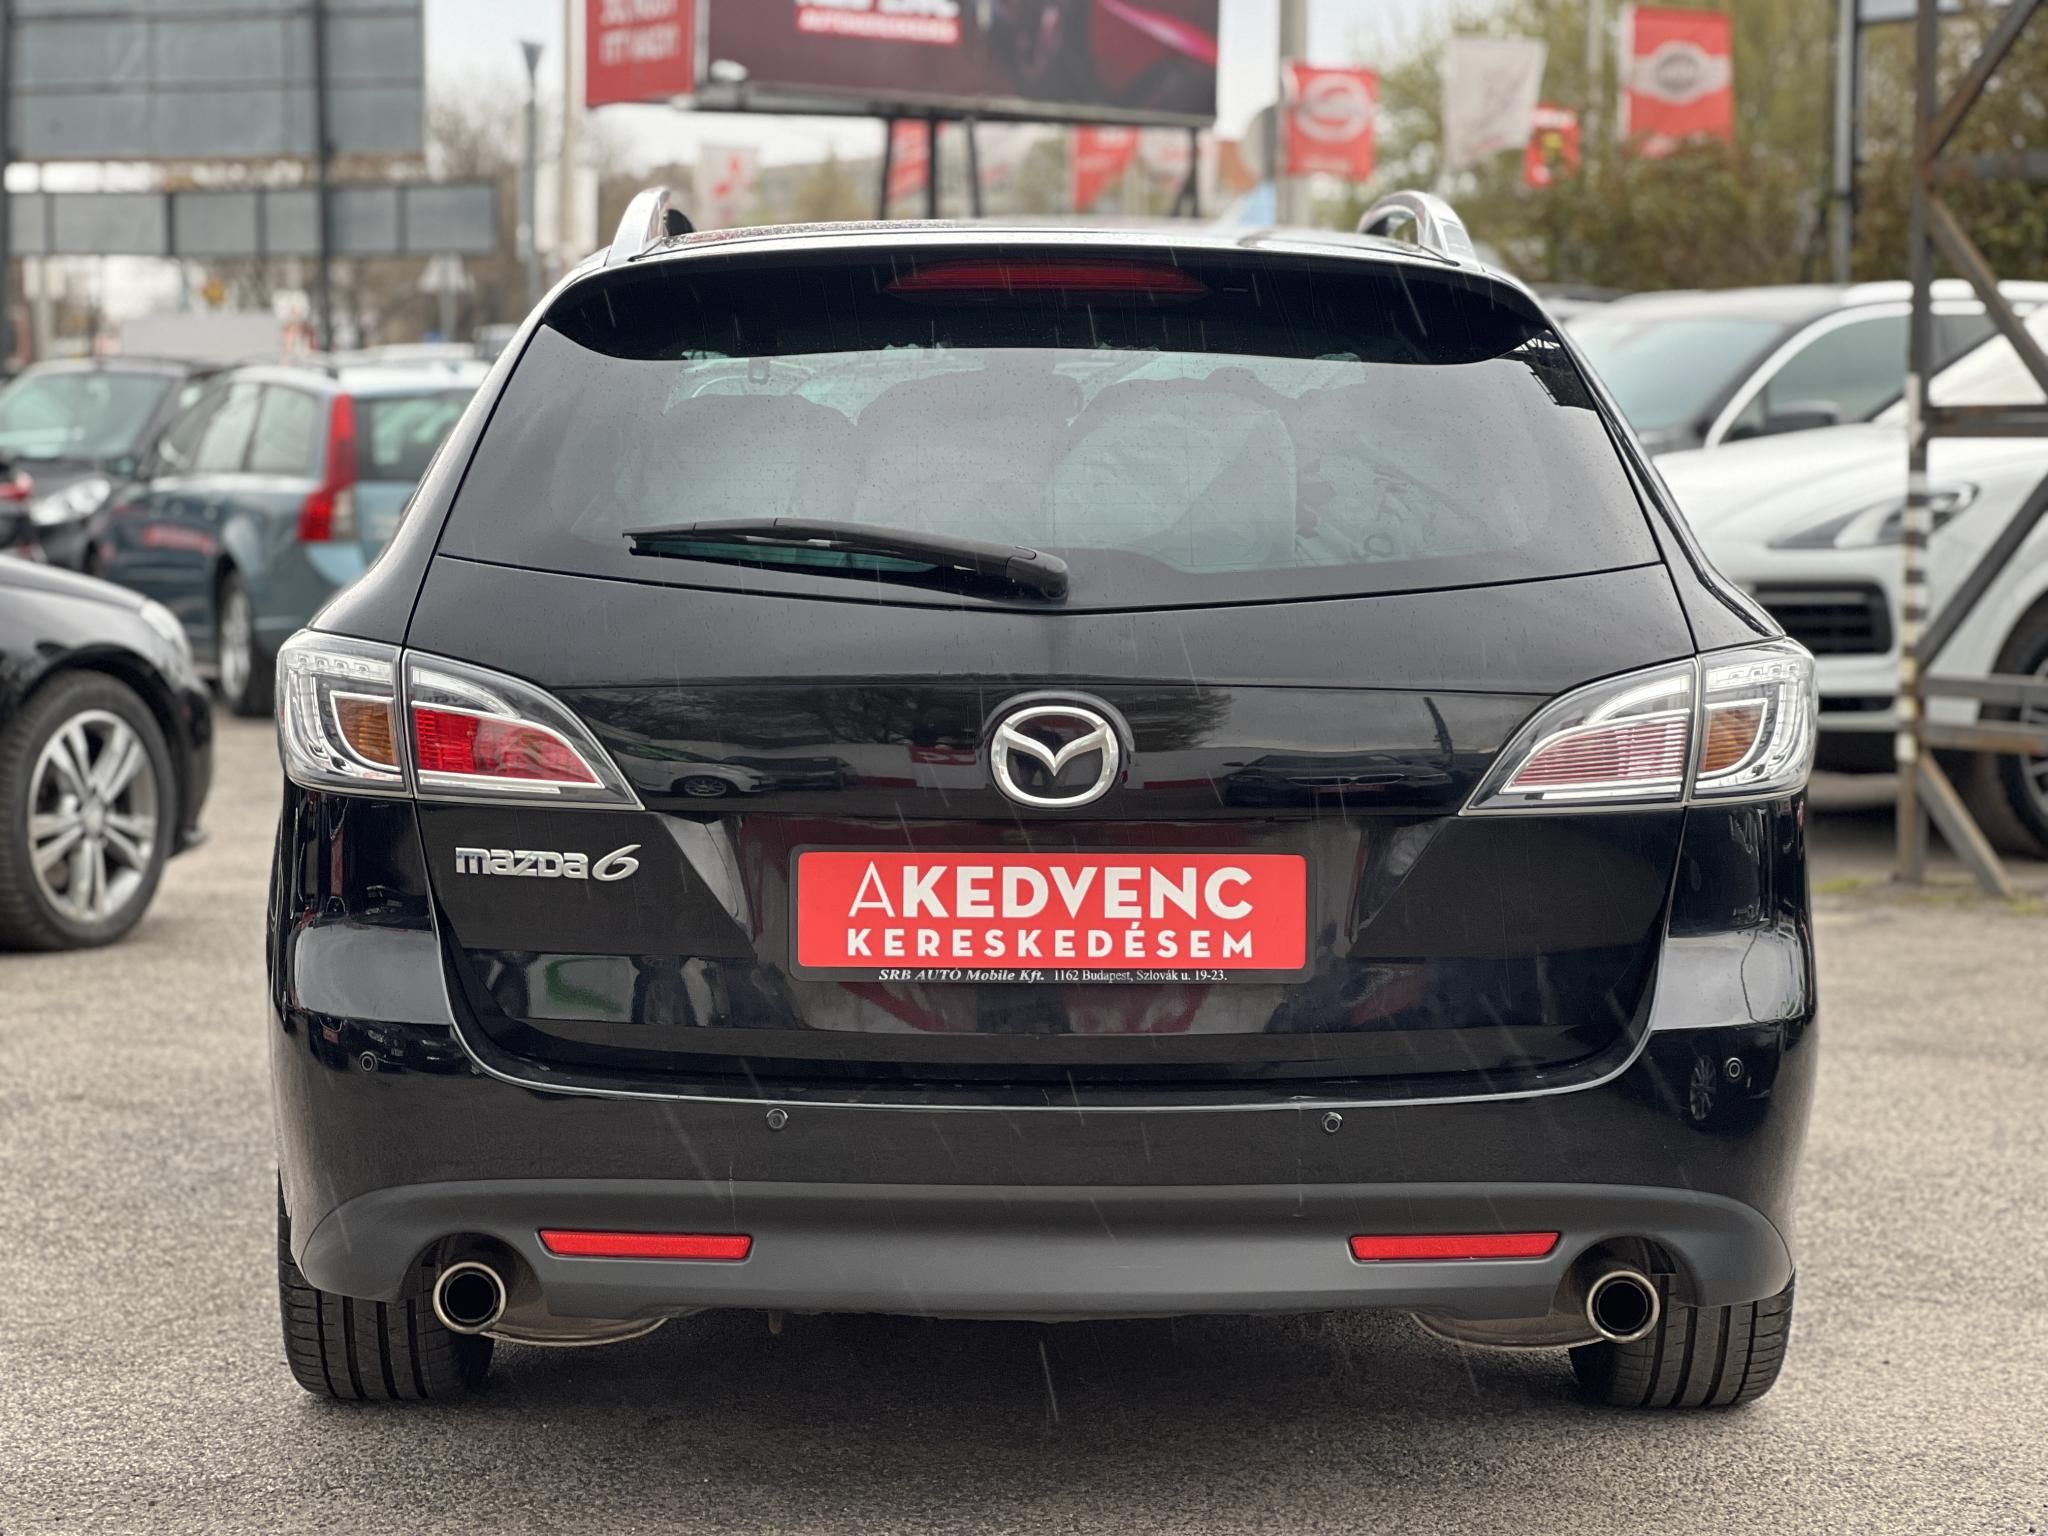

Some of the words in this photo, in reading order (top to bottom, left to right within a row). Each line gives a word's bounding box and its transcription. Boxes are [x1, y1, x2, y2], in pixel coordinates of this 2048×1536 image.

[847, 921, 1254, 959] KERESKEDÉSEM
[878, 969, 911, 981] SRB
[914, 967, 961, 981] AUTÓ
[965, 969, 1015, 981] Mobile
[1018, 969, 1045, 983] Kft.
[1054, 969, 1079, 981] 1162
[1081, 969, 1134, 983] Budapest,
[1136, 969, 1178, 981] Szlovák
[1181, 971, 1191, 981] u.
[1195, 969, 1228, 981] 19-23.
